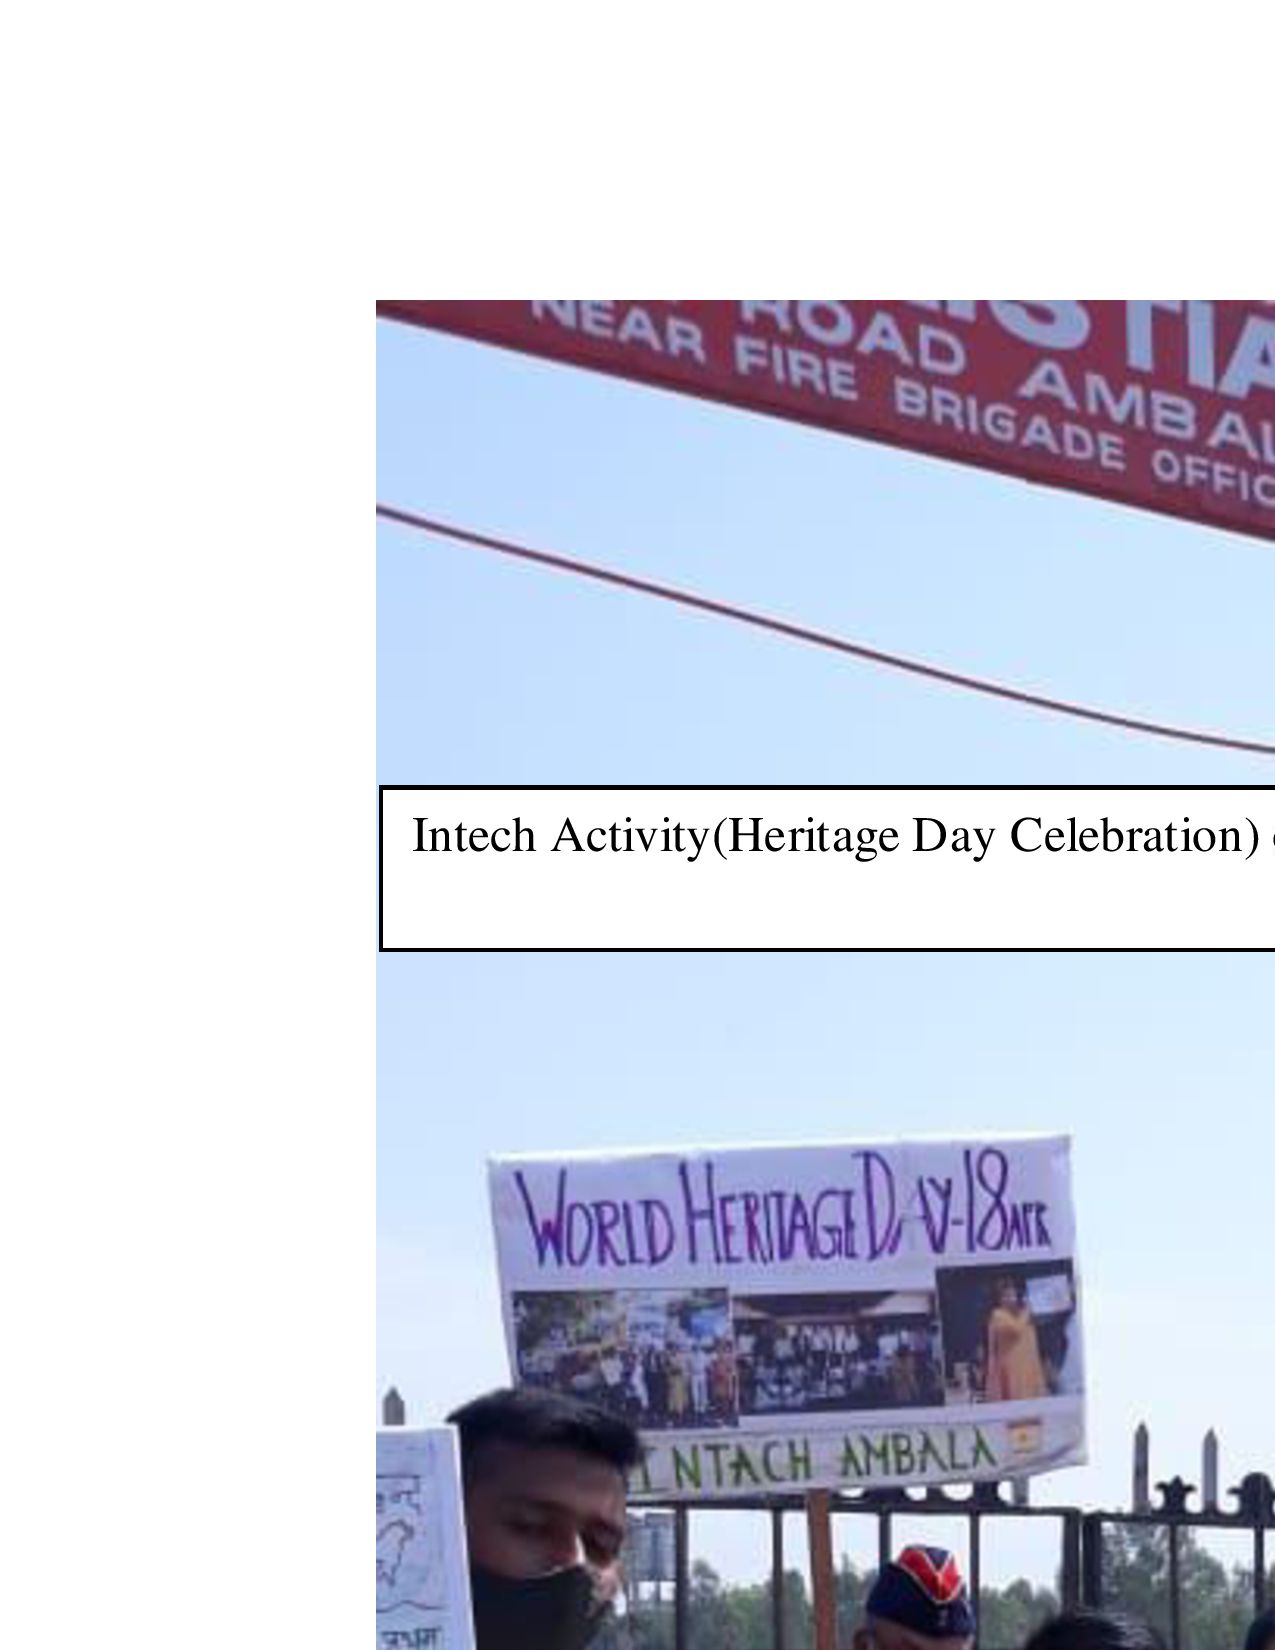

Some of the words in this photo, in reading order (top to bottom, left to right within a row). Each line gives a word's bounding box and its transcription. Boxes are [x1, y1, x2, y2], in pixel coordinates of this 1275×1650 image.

[530, 300, 707, 364] NEAR
[734, 335, 859, 401] FIRE
[893, 378, 1128, 473] BRIGADE
[514, 1167, 677, 1267] WORLD
[678, 1158, 860, 1266] HERITAGE
[839, 1424, 999, 1479] AMBALA
